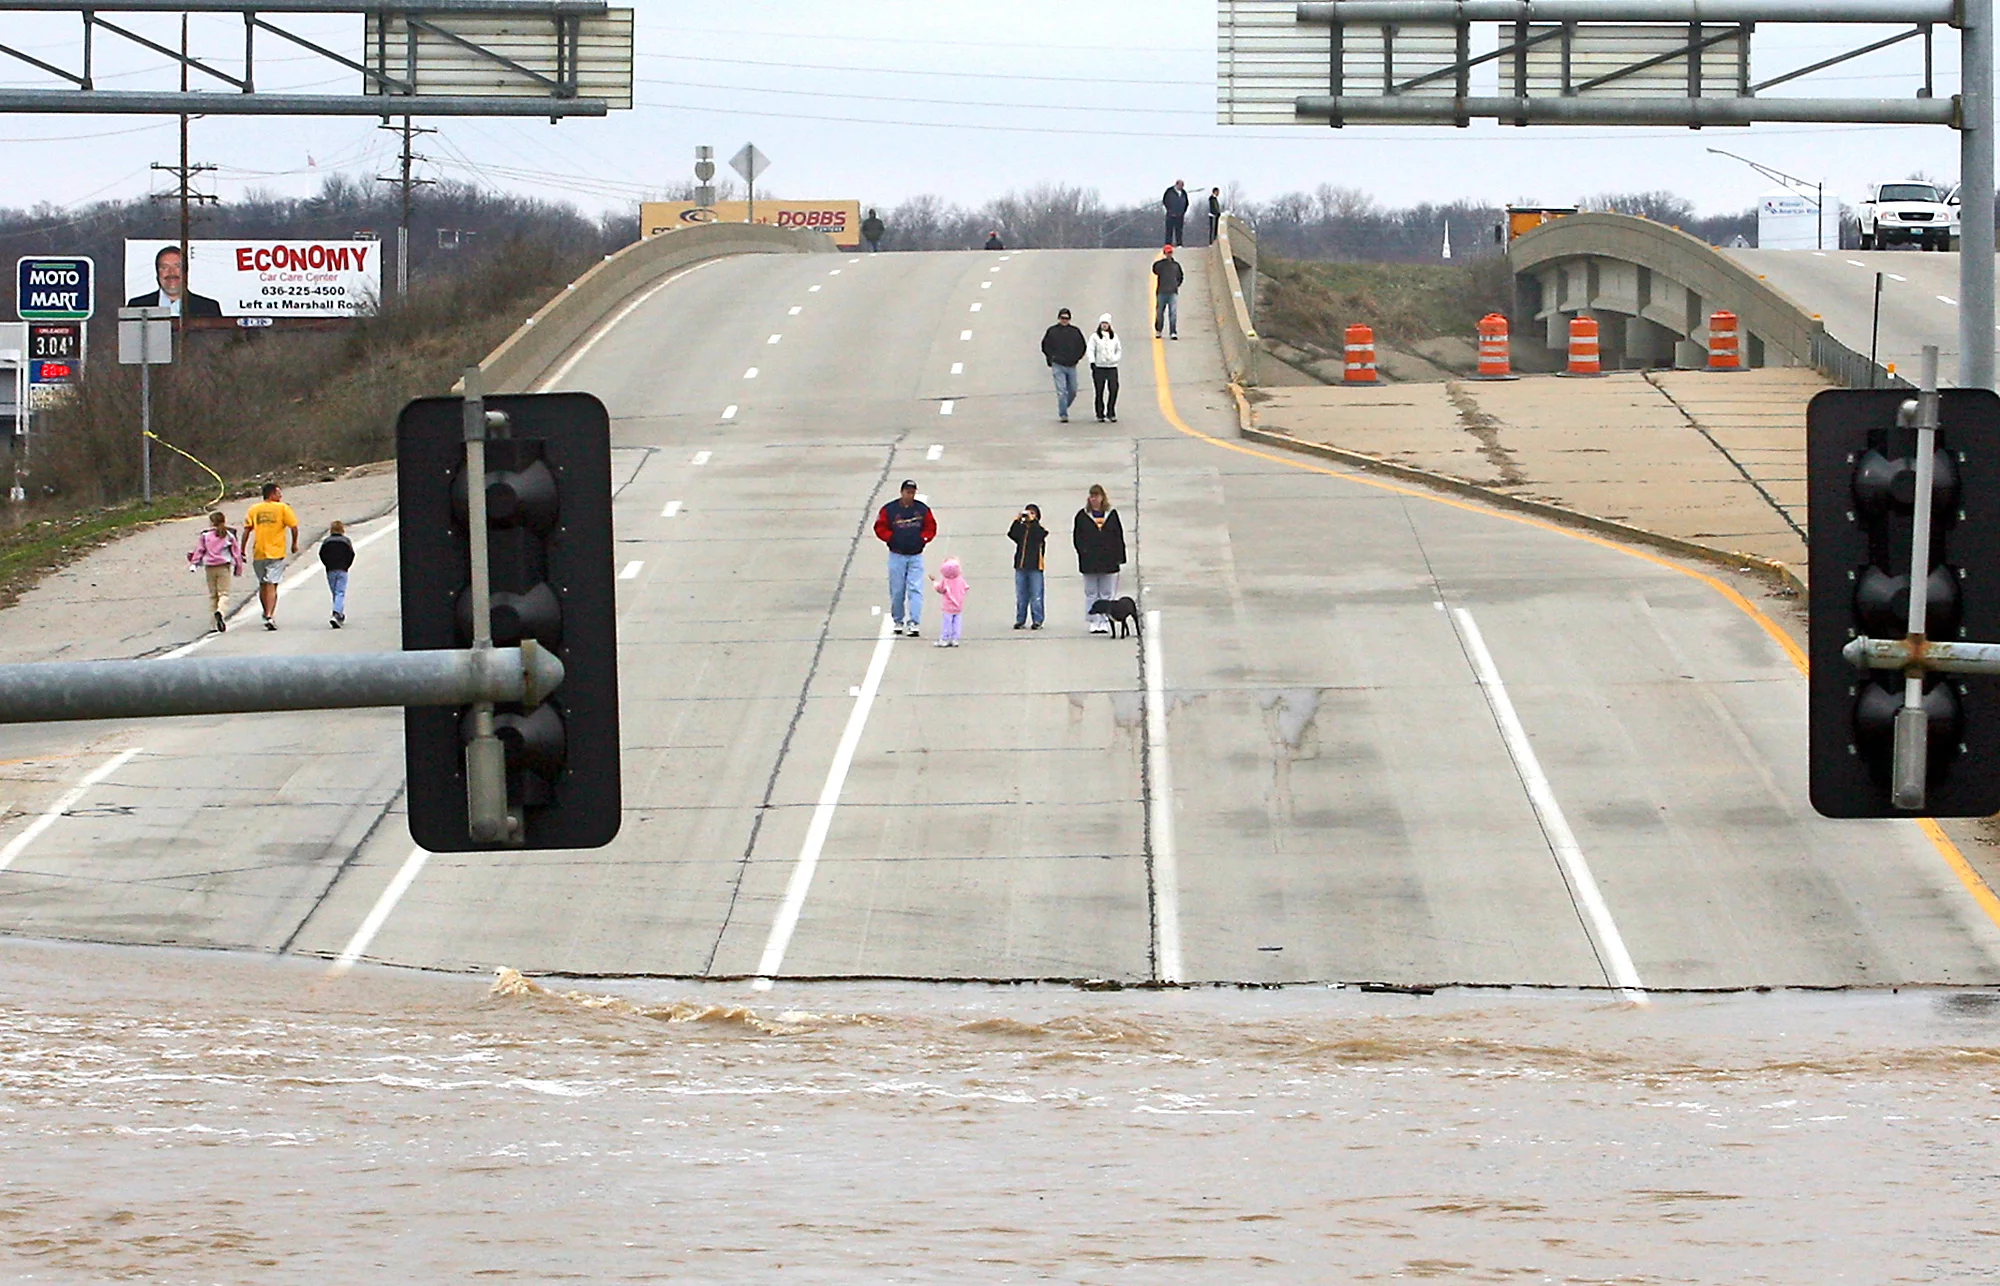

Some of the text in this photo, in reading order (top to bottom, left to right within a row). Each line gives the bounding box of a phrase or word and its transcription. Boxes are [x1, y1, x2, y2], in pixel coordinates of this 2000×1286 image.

[777, 210, 847, 226] DOBBS
[236, 245, 368, 272] ECONOMY
[29, 271, 80, 285] MOTO
[259, 272, 339, 282] Car Care Center
[261, 286, 345, 296] 636-225-4500
[30, 292, 79, 312] MART
[239, 300, 263, 309] Left
[266, 300, 278, 309] at
[281, 300, 334, 309] Marshall
